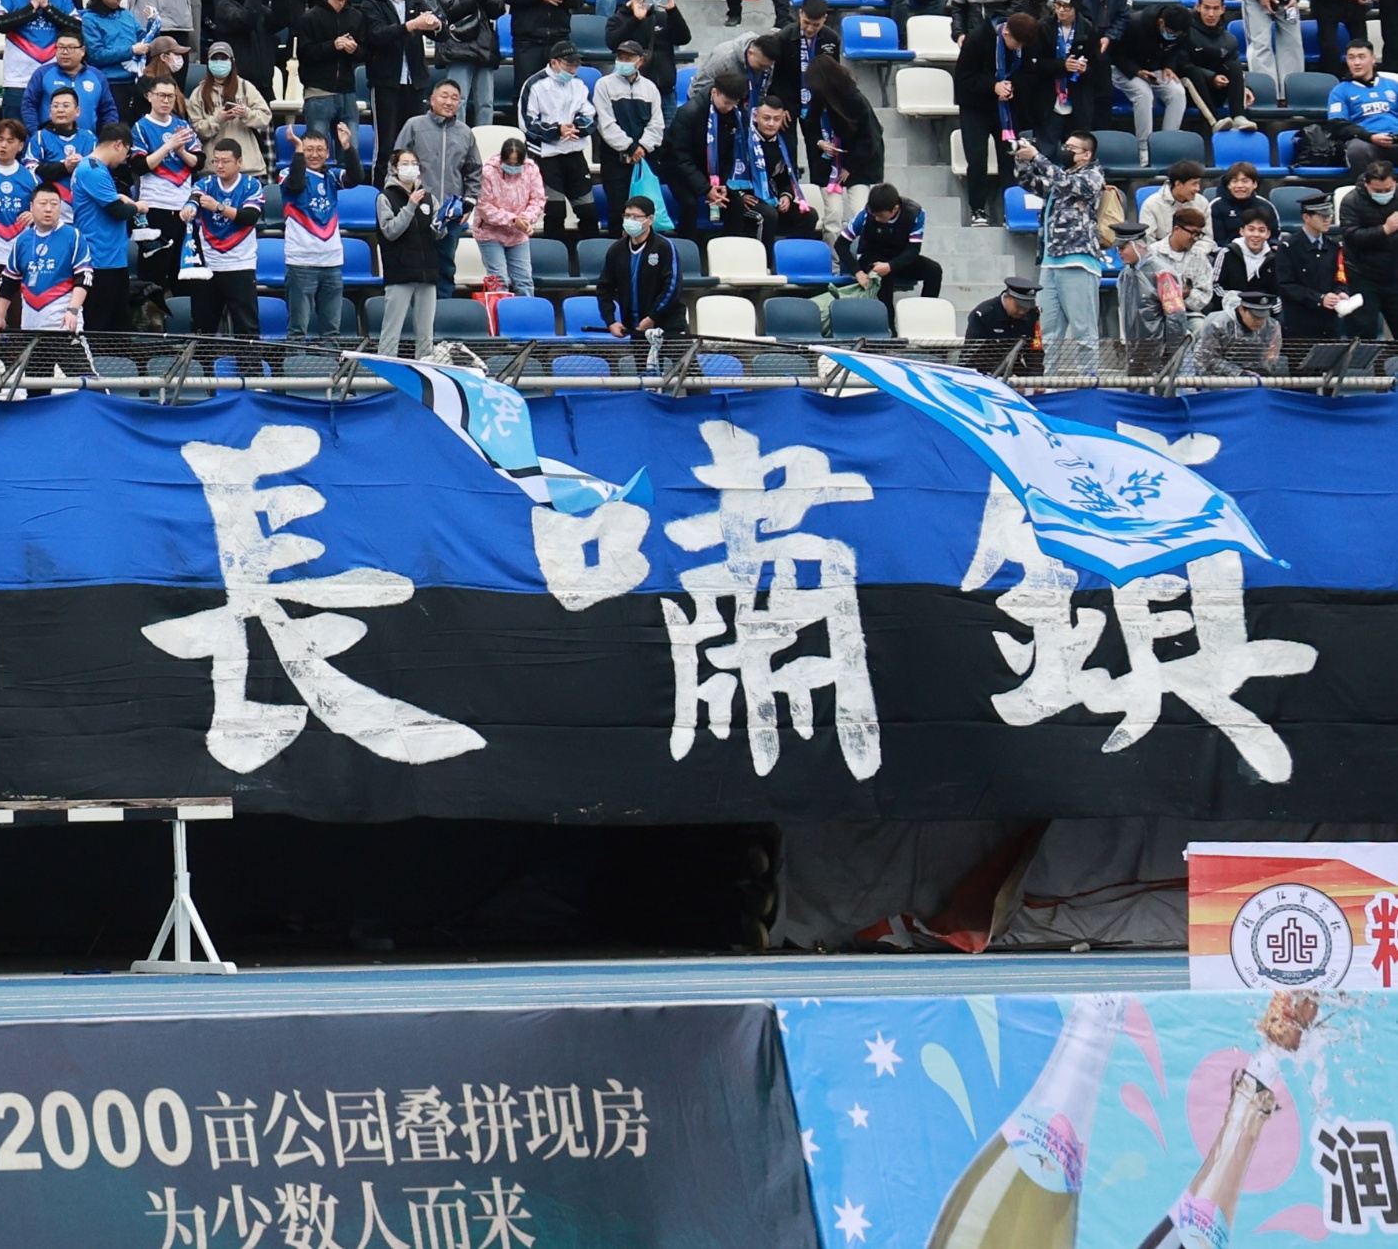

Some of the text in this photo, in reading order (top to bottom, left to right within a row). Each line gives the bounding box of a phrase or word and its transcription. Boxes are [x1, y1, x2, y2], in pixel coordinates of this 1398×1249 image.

[145, 1177, 535, 1249] 为少数人而来
[1318, 1125, 1398, 1225] 润
